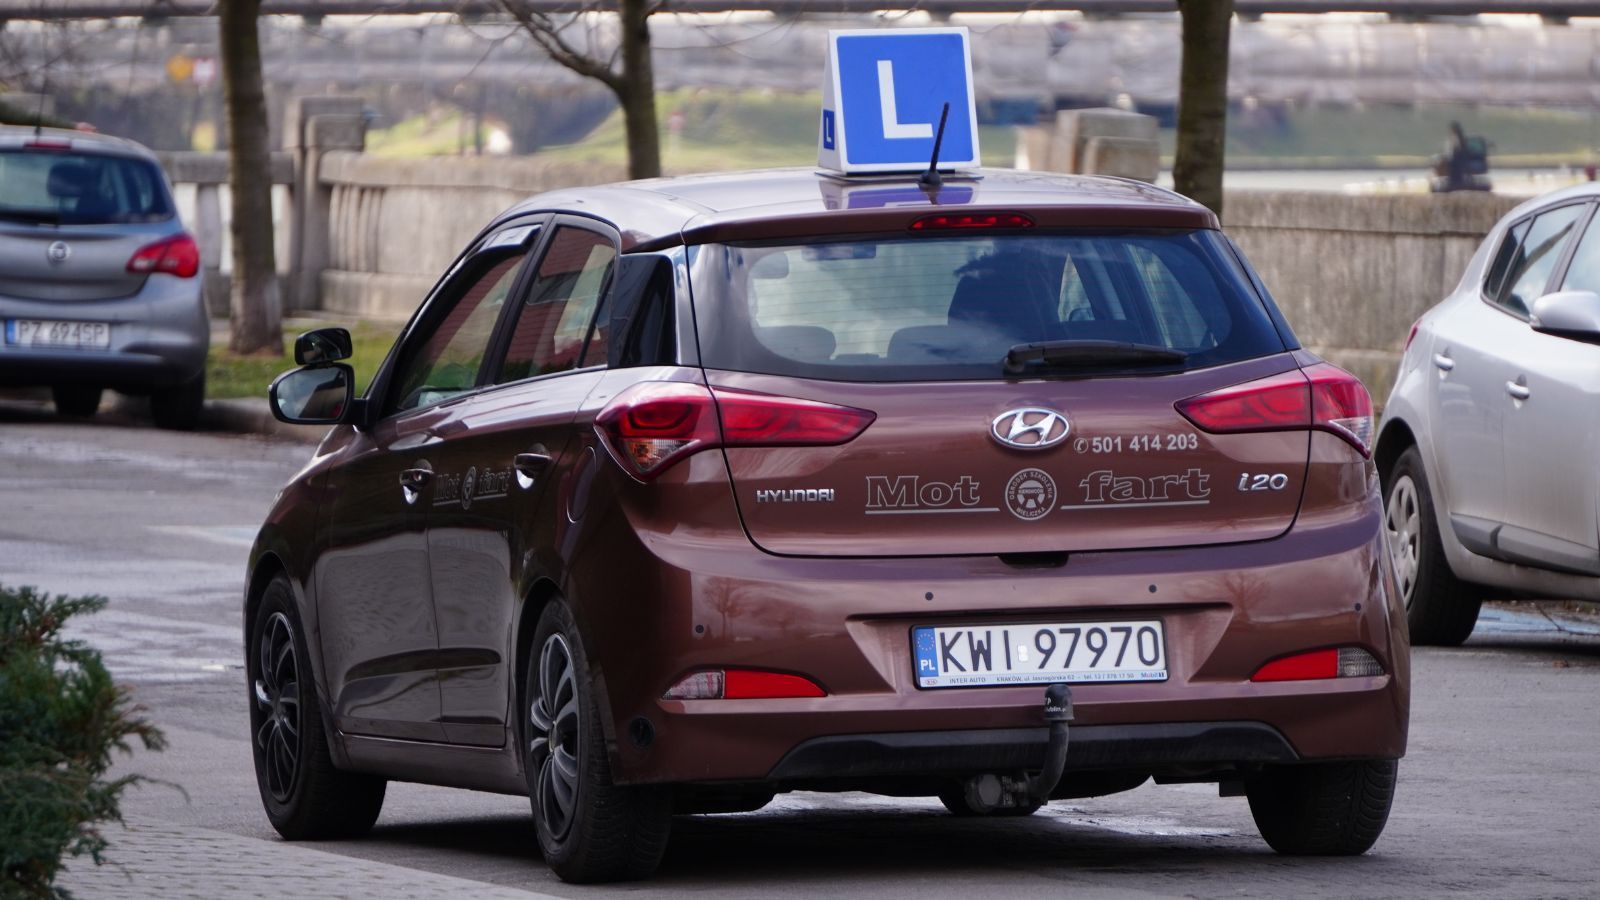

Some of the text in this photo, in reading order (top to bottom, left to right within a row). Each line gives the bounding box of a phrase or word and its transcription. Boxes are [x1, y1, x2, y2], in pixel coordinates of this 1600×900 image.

[877, 60, 934, 139] L
[825, 116, 832, 143] L
[19, 321, 42, 341] PZ
[1092, 433, 1198, 453] 501 414 203
[865, 468, 1211, 507] Mot fart
[1238, 472, 1289, 492] i20
[757, 488, 835, 502] HYUNDAI
[939, 626, 1161, 673] KWI 97970
[920, 659, 936, 671] PL
